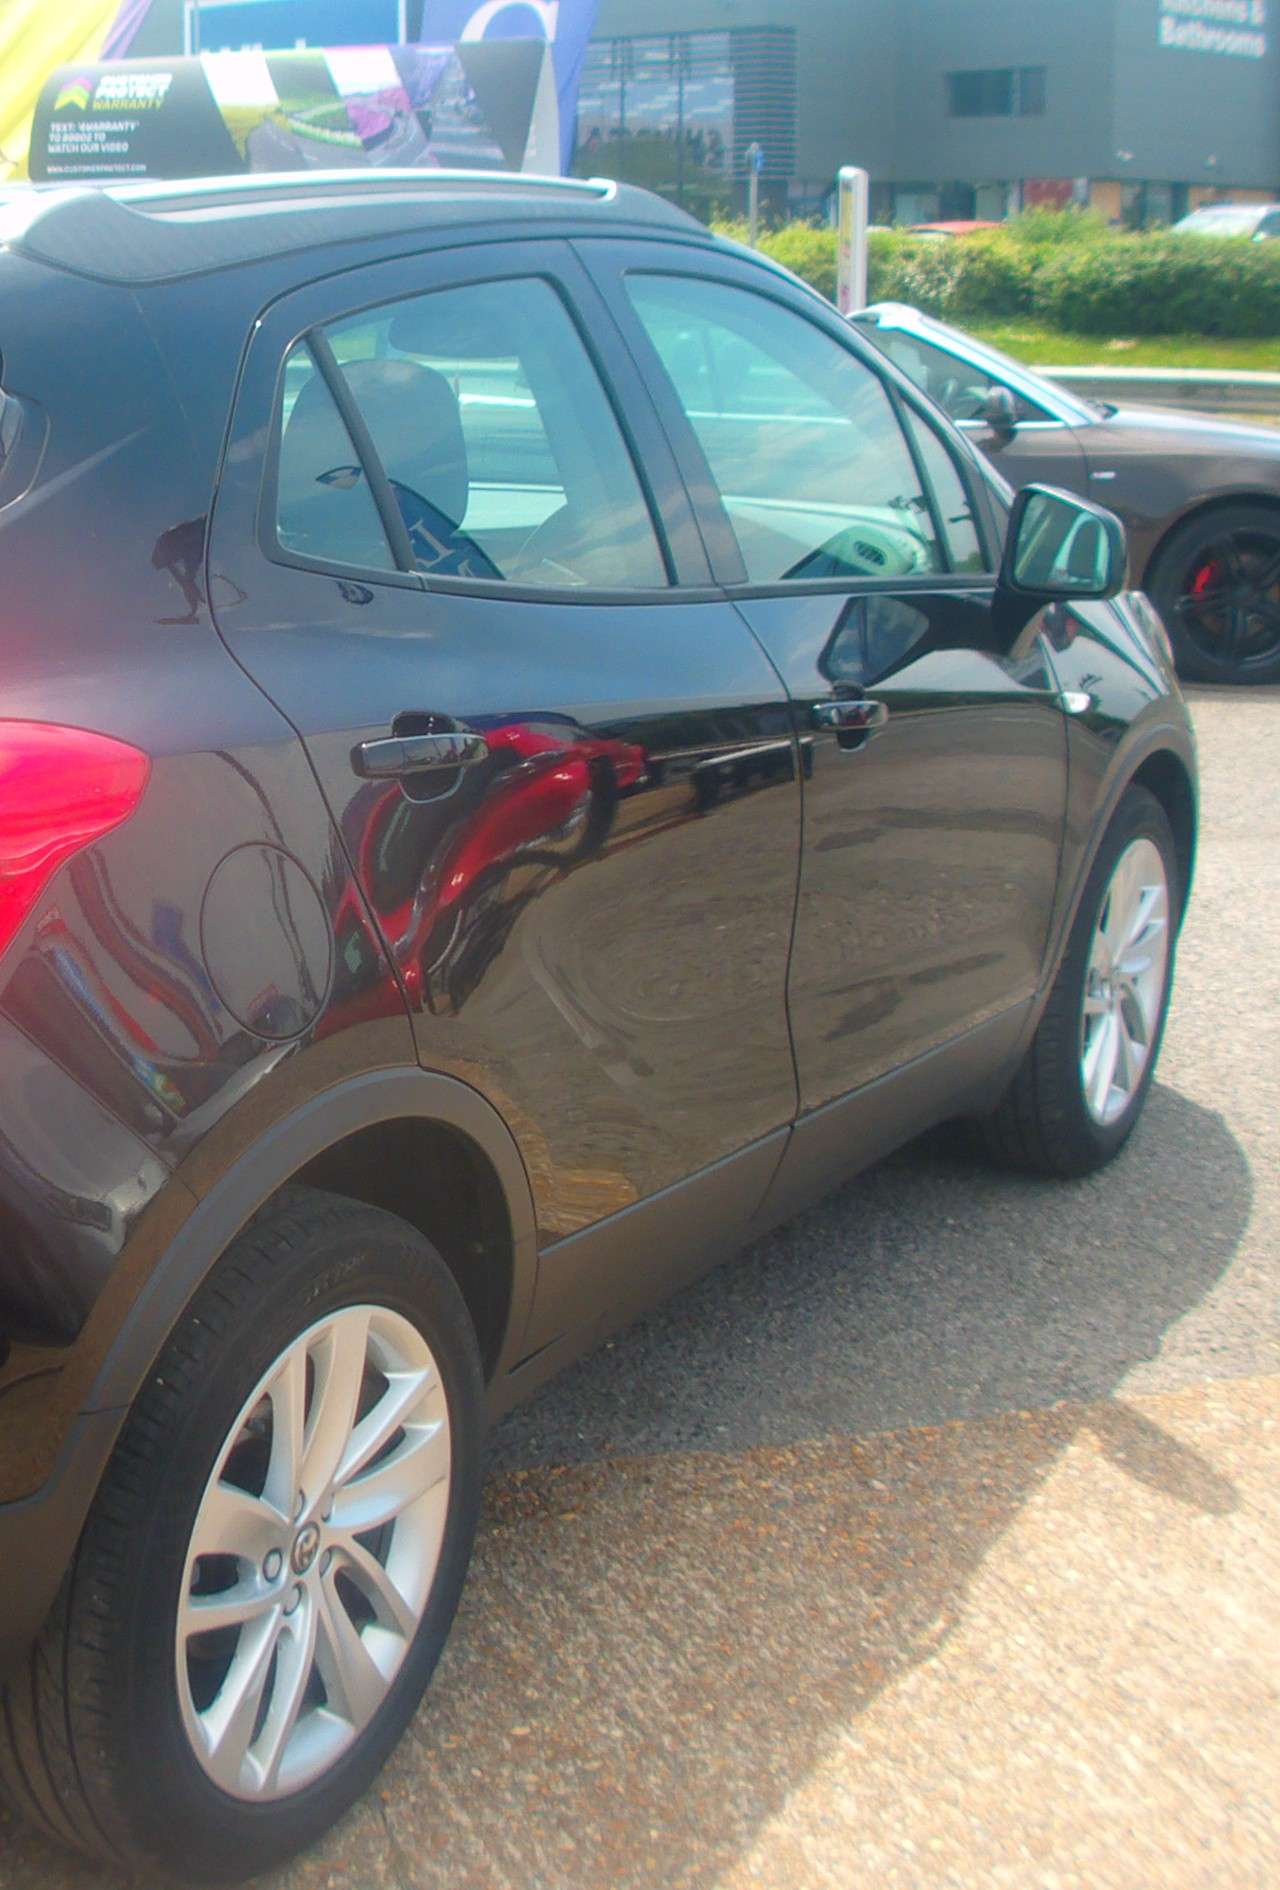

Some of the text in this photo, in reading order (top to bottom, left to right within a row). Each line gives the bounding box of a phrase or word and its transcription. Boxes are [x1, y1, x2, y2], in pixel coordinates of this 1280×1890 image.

[93, 97, 166, 110] WARRANTY
[48, 142, 129, 153] WATCH OUR VIDEO
